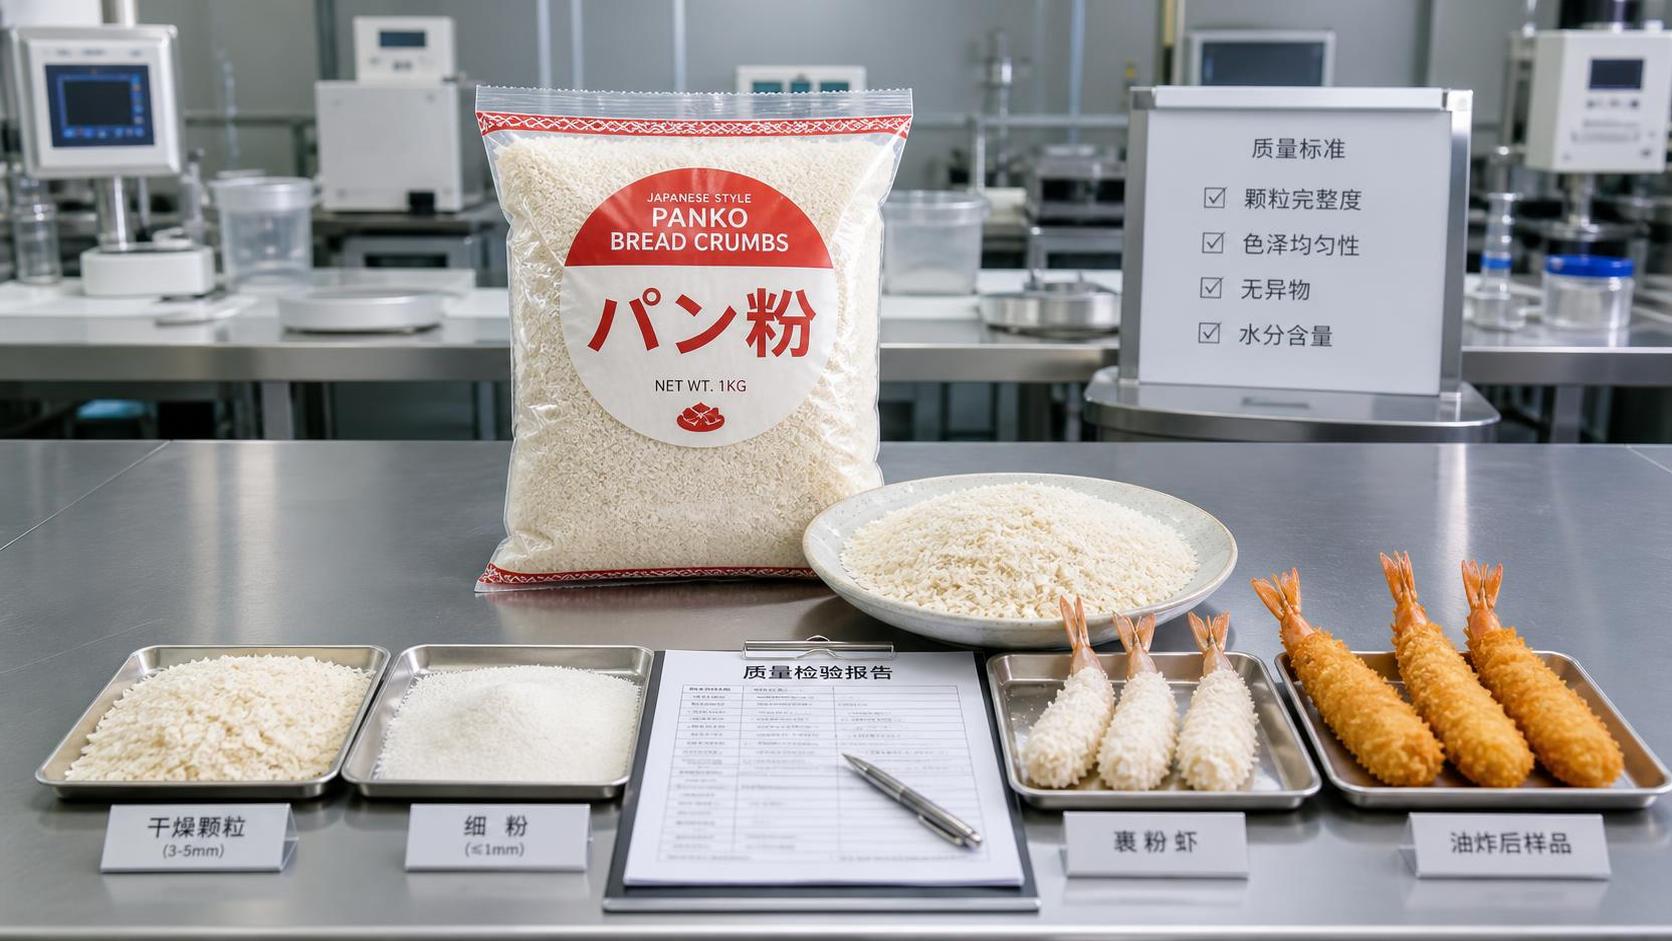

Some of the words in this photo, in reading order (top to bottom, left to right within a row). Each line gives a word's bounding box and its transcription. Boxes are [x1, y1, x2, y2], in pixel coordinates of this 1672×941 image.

[1251, 137, 1346, 160] 质量标准
[647, 192, 710, 204] JAPANESE
[714, 192, 752, 204] STYLE
[1244, 187, 1362, 211] 颗粒完整度
[652, 207, 748, 229] PANKO
[611, 231, 687, 253] BREAD
[693, 231, 789, 253] CRUMBS
[1242, 232, 1360, 257] 色泽均匀性
[1241, 278, 1311, 301] 无异物
[588, 287, 817, 359] パン粉
[1239, 322, 1333, 348] 水分含量
[655, 379, 684, 393] NET
[687, 379, 714, 393] WT.
[719, 379, 747, 393] 1KG
[743, 664, 893, 680] 质量检验报告
[147, 815, 246, 838] 干燥颗粒
[163, 844, 225, 858] (3-5mm)
[1451, 832, 1572, 854] 油炸后样品
